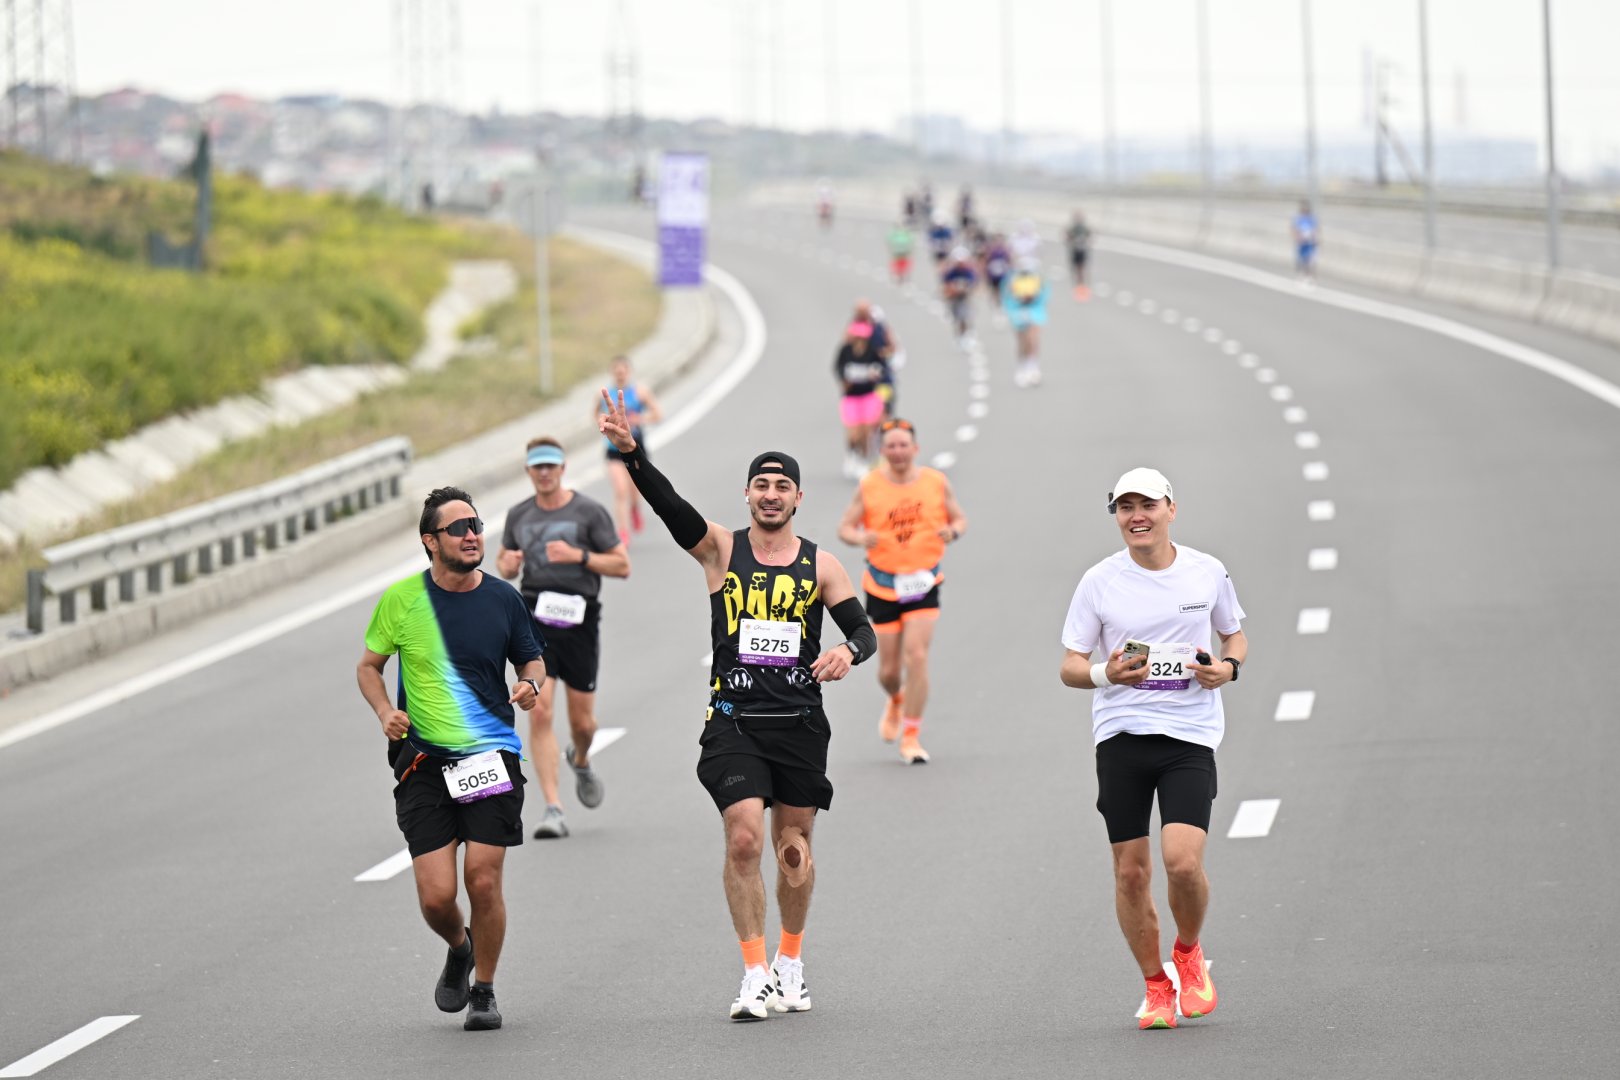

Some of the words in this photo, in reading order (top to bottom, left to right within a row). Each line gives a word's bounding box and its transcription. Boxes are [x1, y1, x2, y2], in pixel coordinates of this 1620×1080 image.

[750, 638, 790, 653] 5275
[1151, 662, 1183, 676] 324
[458, 768, 498, 792] 5055
